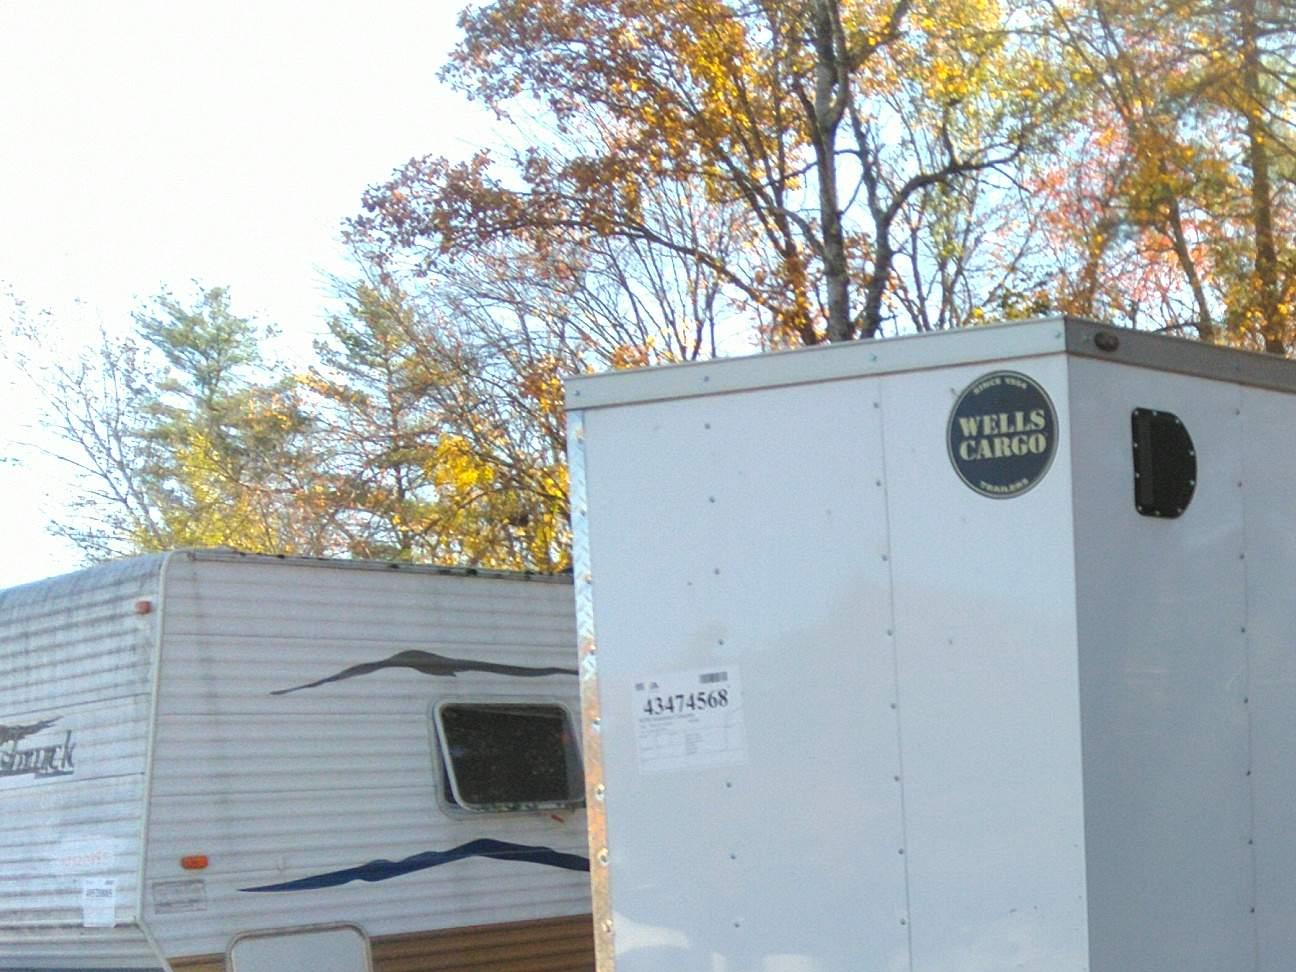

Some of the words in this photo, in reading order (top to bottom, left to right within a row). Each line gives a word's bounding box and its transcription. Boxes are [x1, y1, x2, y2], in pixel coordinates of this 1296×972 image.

[959, 409, 1047, 437] WELLS
[959, 433, 1047, 461] CARGO
[643, 689, 728, 715] 43474568
